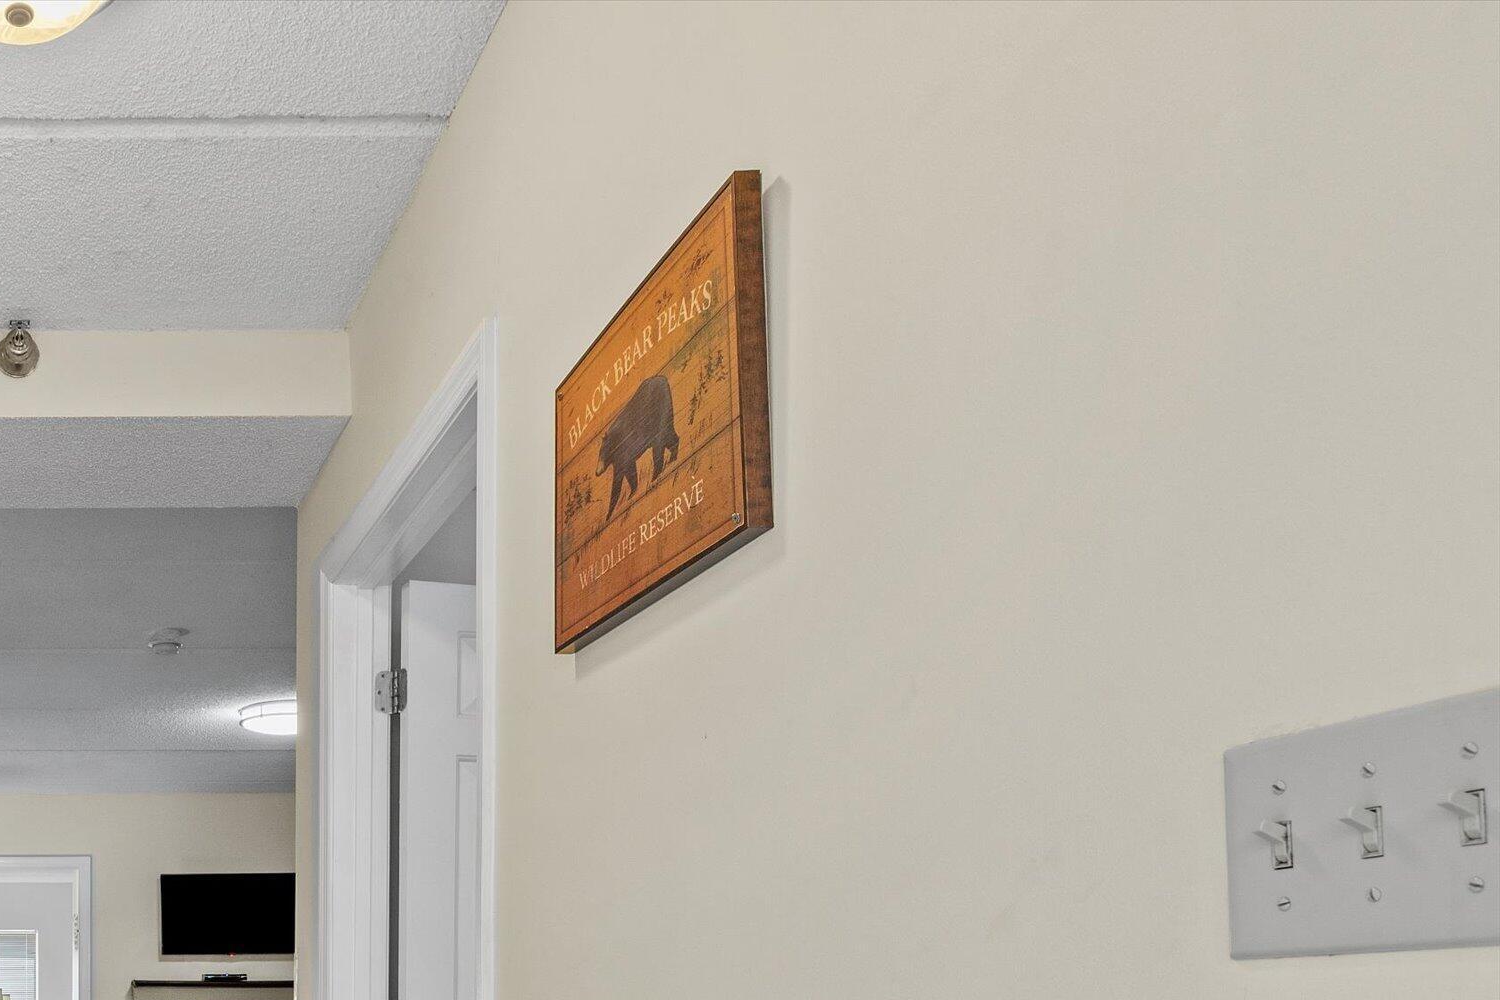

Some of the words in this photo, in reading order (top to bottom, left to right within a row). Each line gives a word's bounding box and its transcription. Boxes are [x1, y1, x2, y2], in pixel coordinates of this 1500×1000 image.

[568, 370, 612, 450] BLACK
[613, 325, 654, 387] BEAR
[656, 280, 713, 343] PEAKS
[579, 532, 637, 591] WILDLIFE
[638, 478, 705, 545] RESERVE
